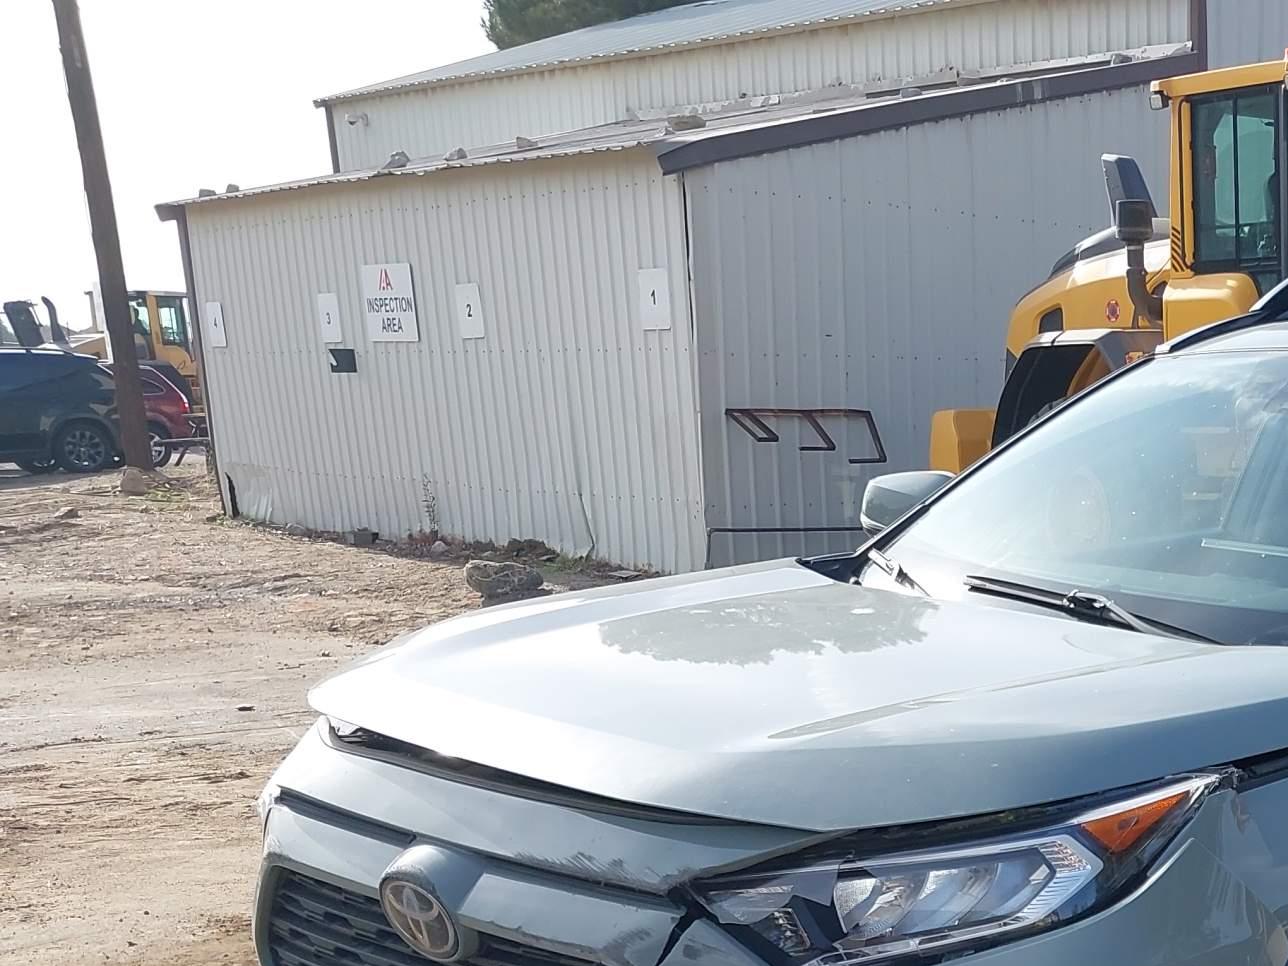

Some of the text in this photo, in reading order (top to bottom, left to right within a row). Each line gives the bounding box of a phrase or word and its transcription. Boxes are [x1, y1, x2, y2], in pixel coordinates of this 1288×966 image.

[366, 296, 413, 313] INSPECTION
[650, 289, 657, 306] 1
[325, 311, 332, 325] 3
[466, 303, 473, 318] 2
[382, 317, 404, 333] AREA
